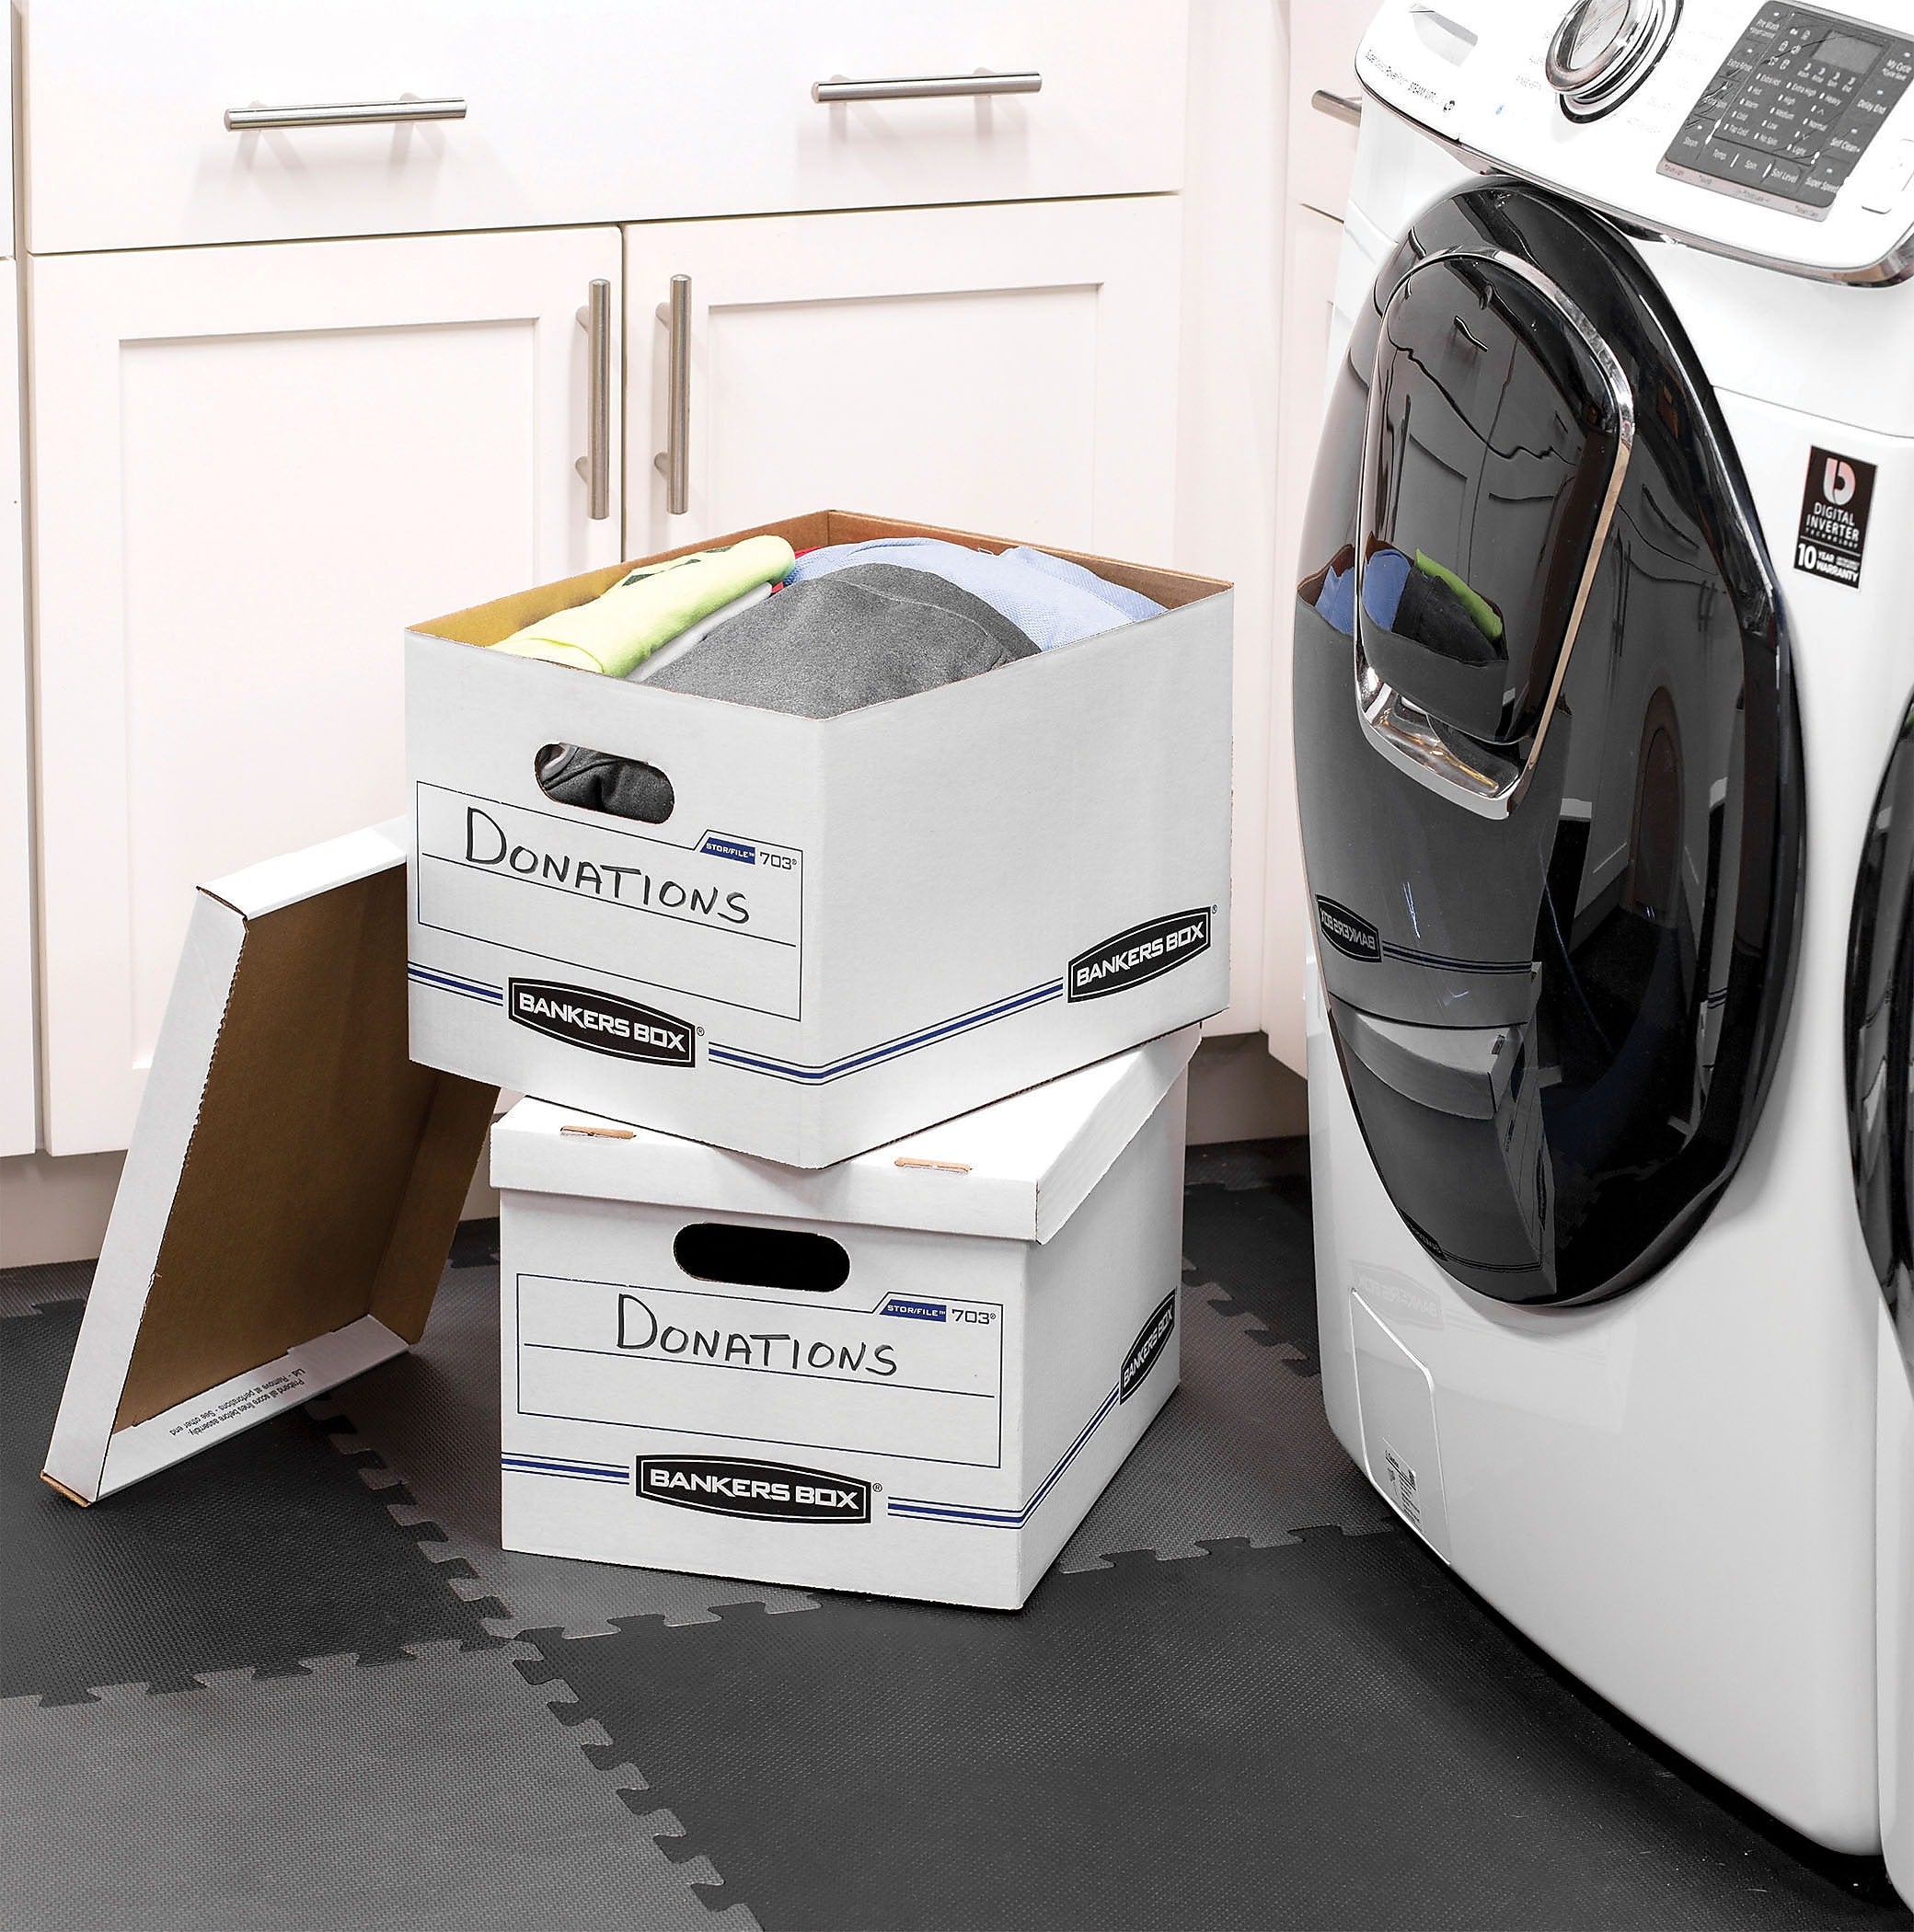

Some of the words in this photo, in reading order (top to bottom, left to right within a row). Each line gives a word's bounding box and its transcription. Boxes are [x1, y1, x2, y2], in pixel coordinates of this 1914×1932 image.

[1886, 59, 1897, 69] My
[1857, 98, 1874, 112] Delay
[1873, 103, 1887, 115] End
[1814, 502, 1855, 526] DIGITAL
[1806, 514, 1859, 541] INVERTER
[1797, 543, 1817, 569] 10
[1818, 551, 1835, 563] YEAR
[1816, 560, 1859, 582] WARRANTY
[466, 806, 750, 924] DONATIONS
[1076, 937, 1164, 987] BANKERS
[1166, 921, 1205, 952] BOX
[519, 993, 631, 1037] BANKERS
[633, 1020, 686, 1052] BOX
[617, 1294, 898, 1376] DONATIONS
[1124, 1326, 1159, 1388] BANKERS
[1157, 1305, 1173, 1339] BOX
[261, 1375, 288, 1390] Remove
[217, 1390, 255, 1409] perforations
[184, 1417, 201, 1429] other
[200, 1410, 216, 1420] See
[169, 1425, 183, 1436] end
[650, 1468, 790, 1501] BANKERS
[795, 1488, 859, 1511] BOX
